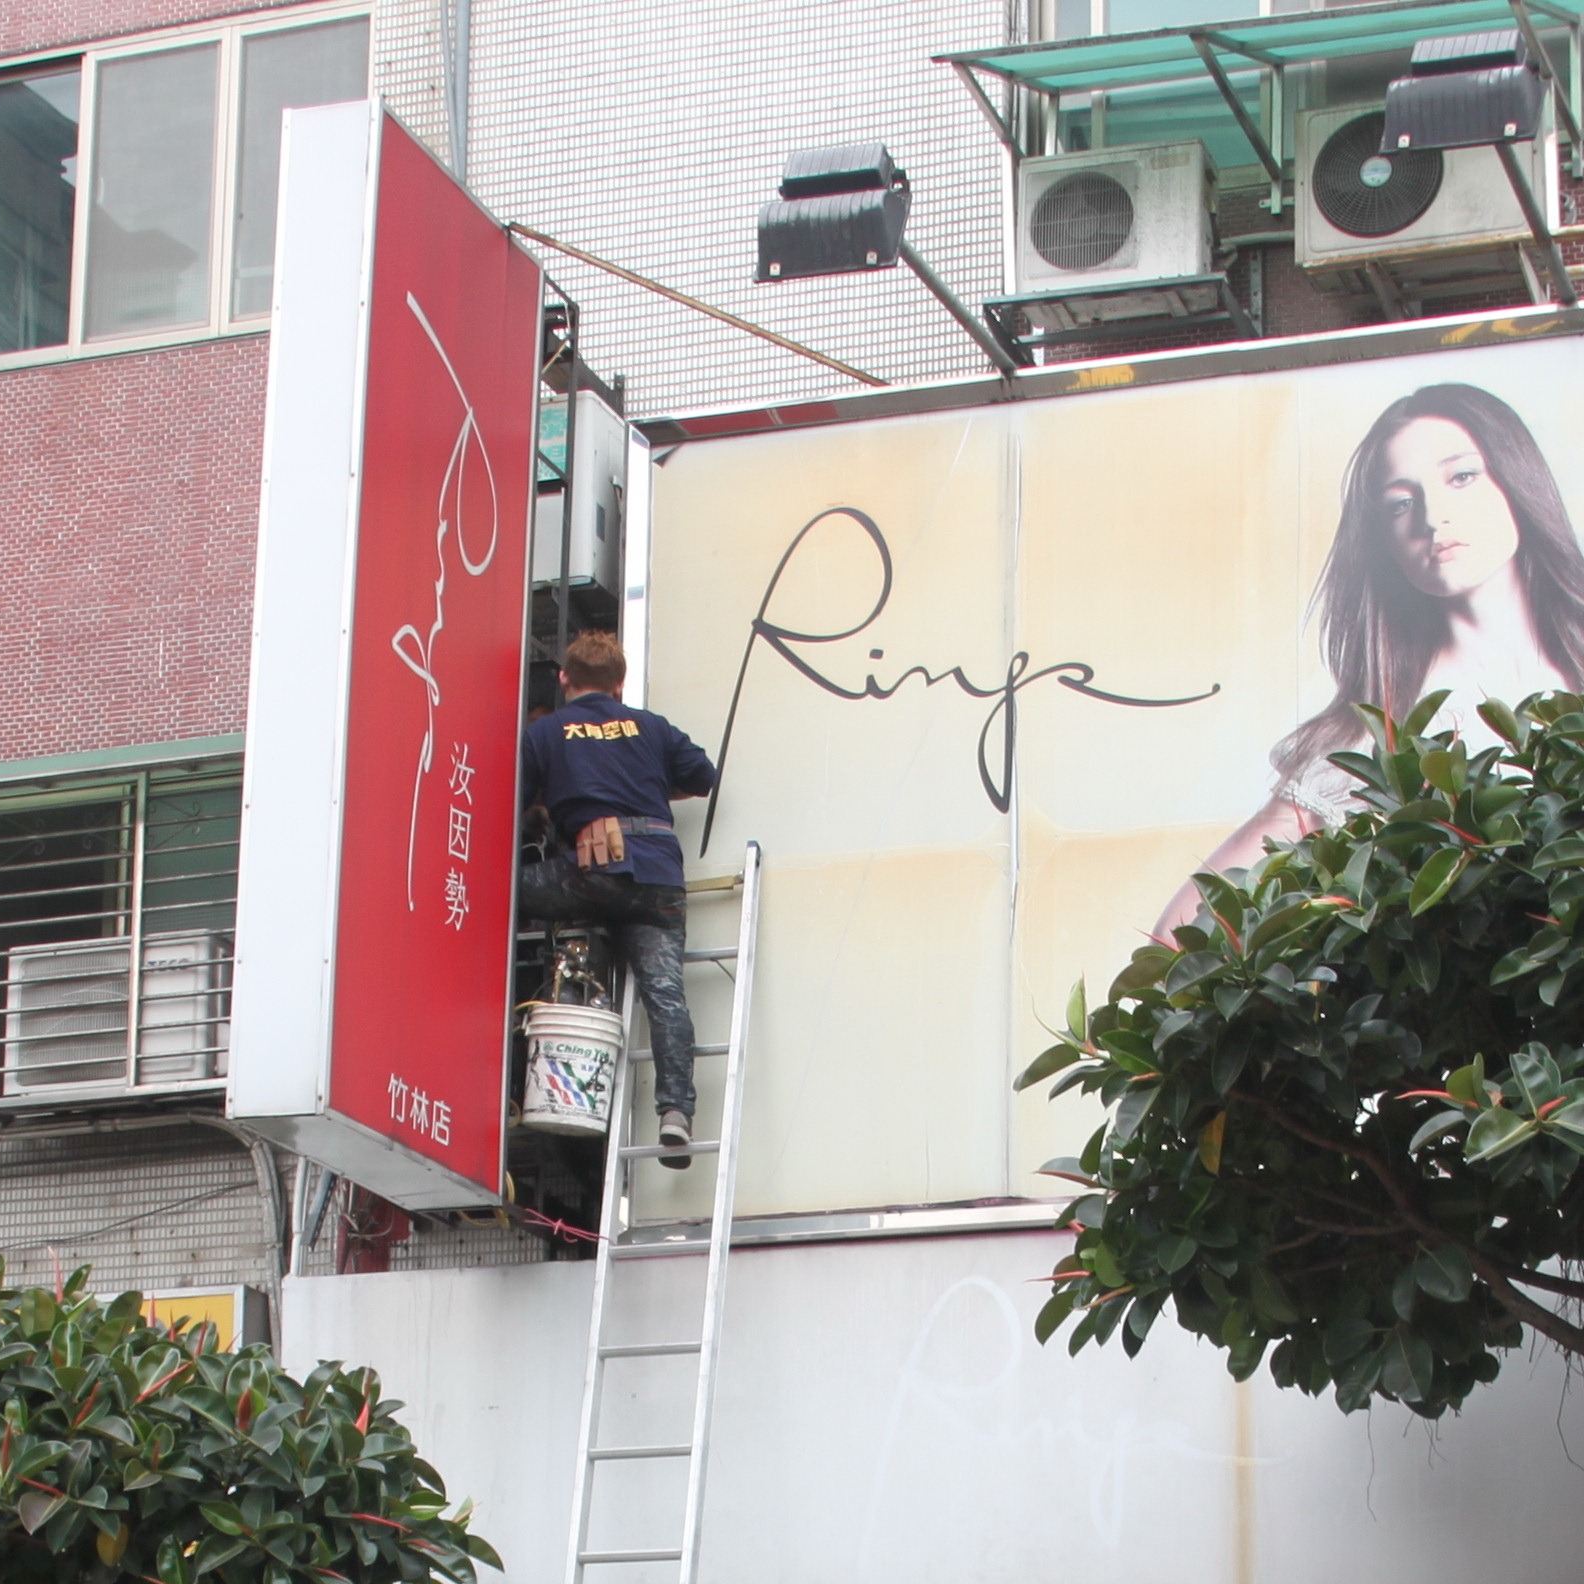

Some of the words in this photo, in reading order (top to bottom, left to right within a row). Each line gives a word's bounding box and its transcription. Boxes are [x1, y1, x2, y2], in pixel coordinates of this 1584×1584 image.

[443, 742, 476, 931] 汝因勢
[386, 1073, 454, 1148] 竹林店
